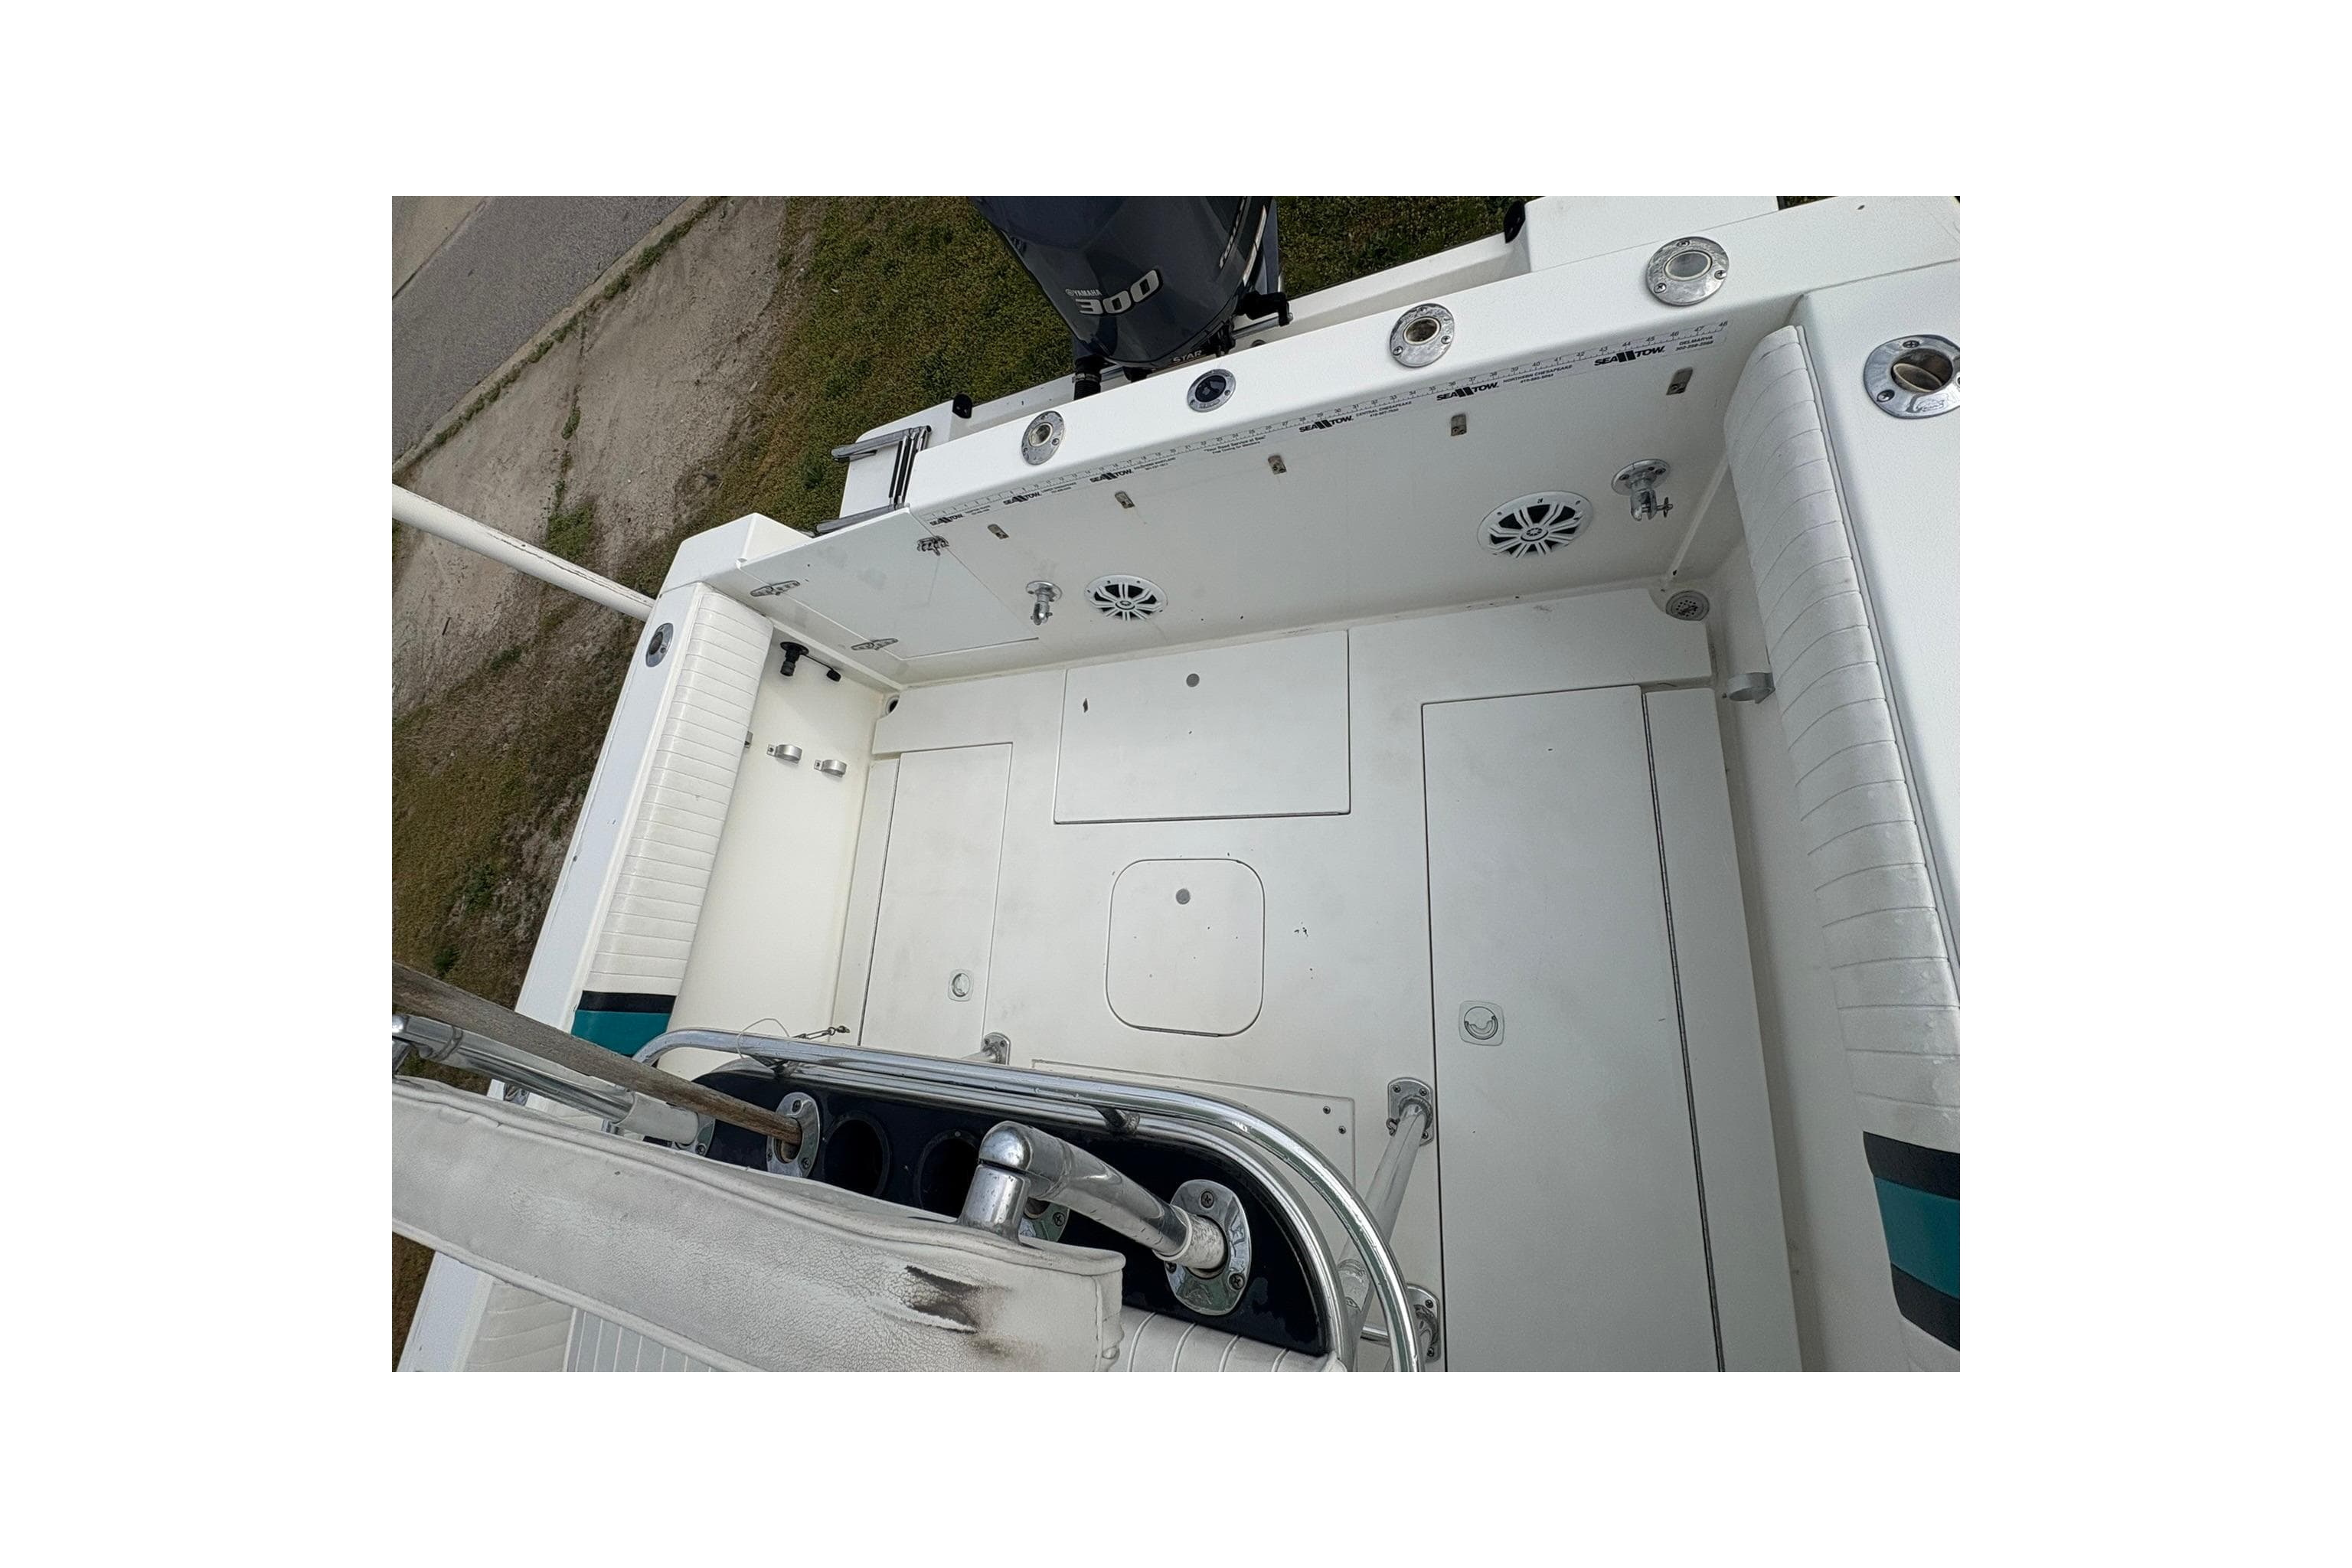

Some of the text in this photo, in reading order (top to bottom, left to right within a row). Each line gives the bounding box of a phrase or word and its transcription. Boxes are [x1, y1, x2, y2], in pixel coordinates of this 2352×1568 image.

[1075, 270, 1159, 315] 300
[1679, 336, 1713, 345] DELMARVA
[1173, 350, 1202, 361] STAR
[1594, 356, 1618, 366] SEA
[1503, 365, 1573, 382] NORTHERN CHESAPEAKE
[1436, 392, 1457, 400] SEA
[1379, 401, 1412, 411] CHESAPEAKE
